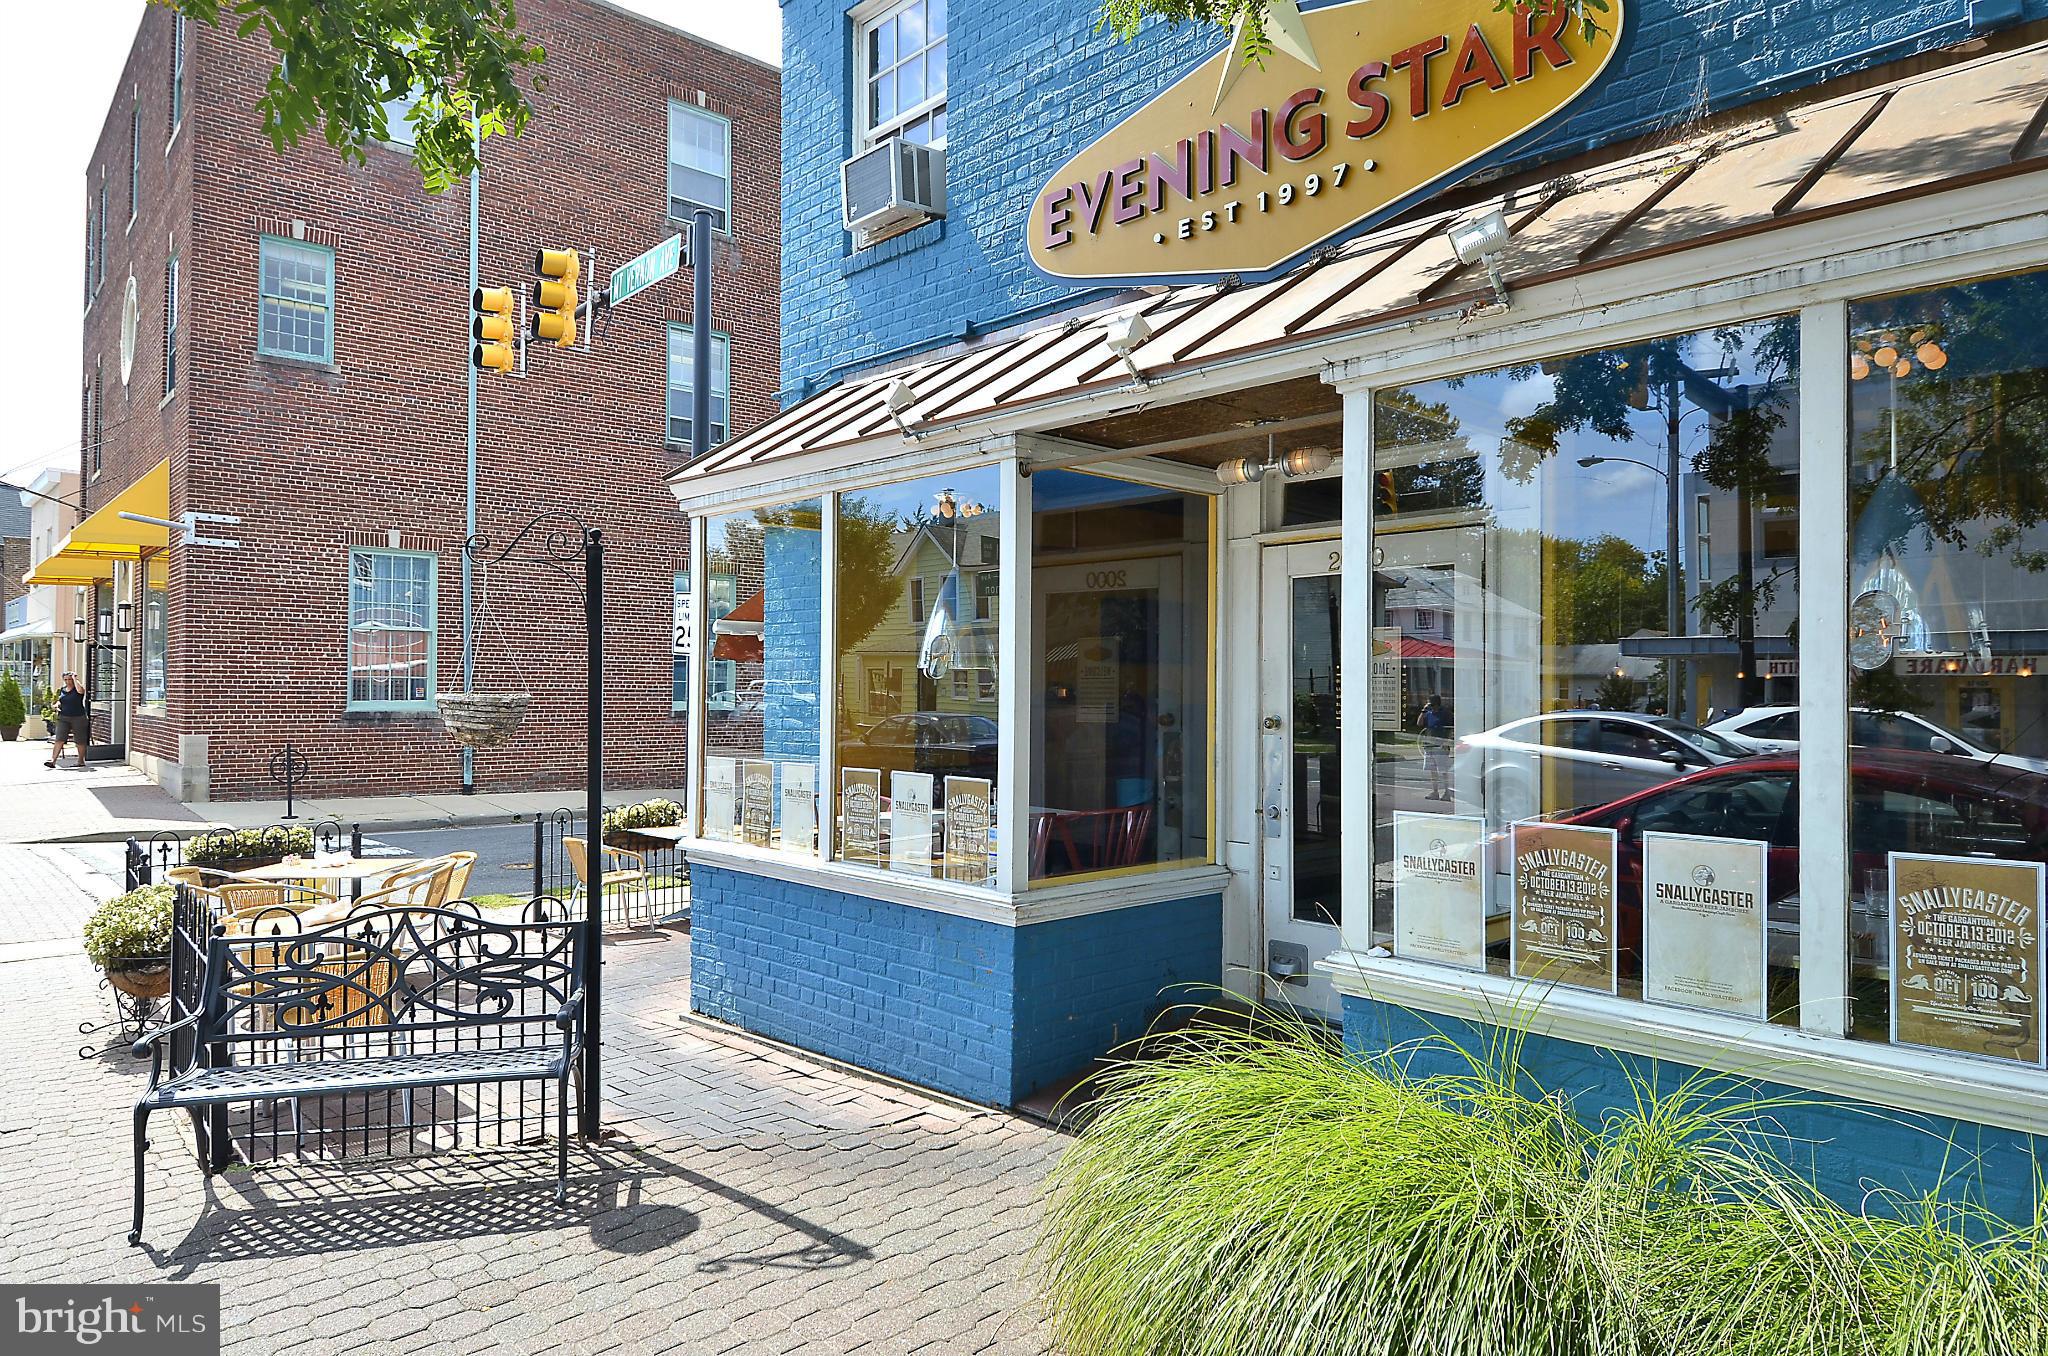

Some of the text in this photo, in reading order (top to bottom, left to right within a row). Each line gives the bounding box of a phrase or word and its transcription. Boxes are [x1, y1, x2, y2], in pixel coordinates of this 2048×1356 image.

[1043, 0, 1576, 252] EVENING STAR
[1179, 163, 1349, 240] EST 1997
[613, 241, 674, 300] MT VERNON AVE
[677, 599, 690, 608] SPE
[678, 612, 690, 621] LIM
[895, 800, 929, 814] SNALLYGASTER
[948, 793, 988, 813] SNALLYGASTER
[1403, 855, 1476, 876] SNALLYGASTER
[1517, 848, 1608, 881] SNALLYGASTER
[1530, 876, 1597, 896] OCTOBER 13 2012
[1656, 882, 1753, 909] SNALLYGASTER
[1898, 887, 2032, 927] SNALLYGASTER
[1540, 921, 1558, 935] OCT
[1933, 914, 1948, 922] THE
[1948, 915, 1996, 927] GARGANTUAN
[1566, 926, 1585, 939] 100
[1917, 920, 2015, 945] OCTOBER 13 2012
[1934, 938, 1996, 952] BEER JAMBOREE
[1933, 977, 1961, 994] OCT
[1970, 982, 1998, 999] 100
